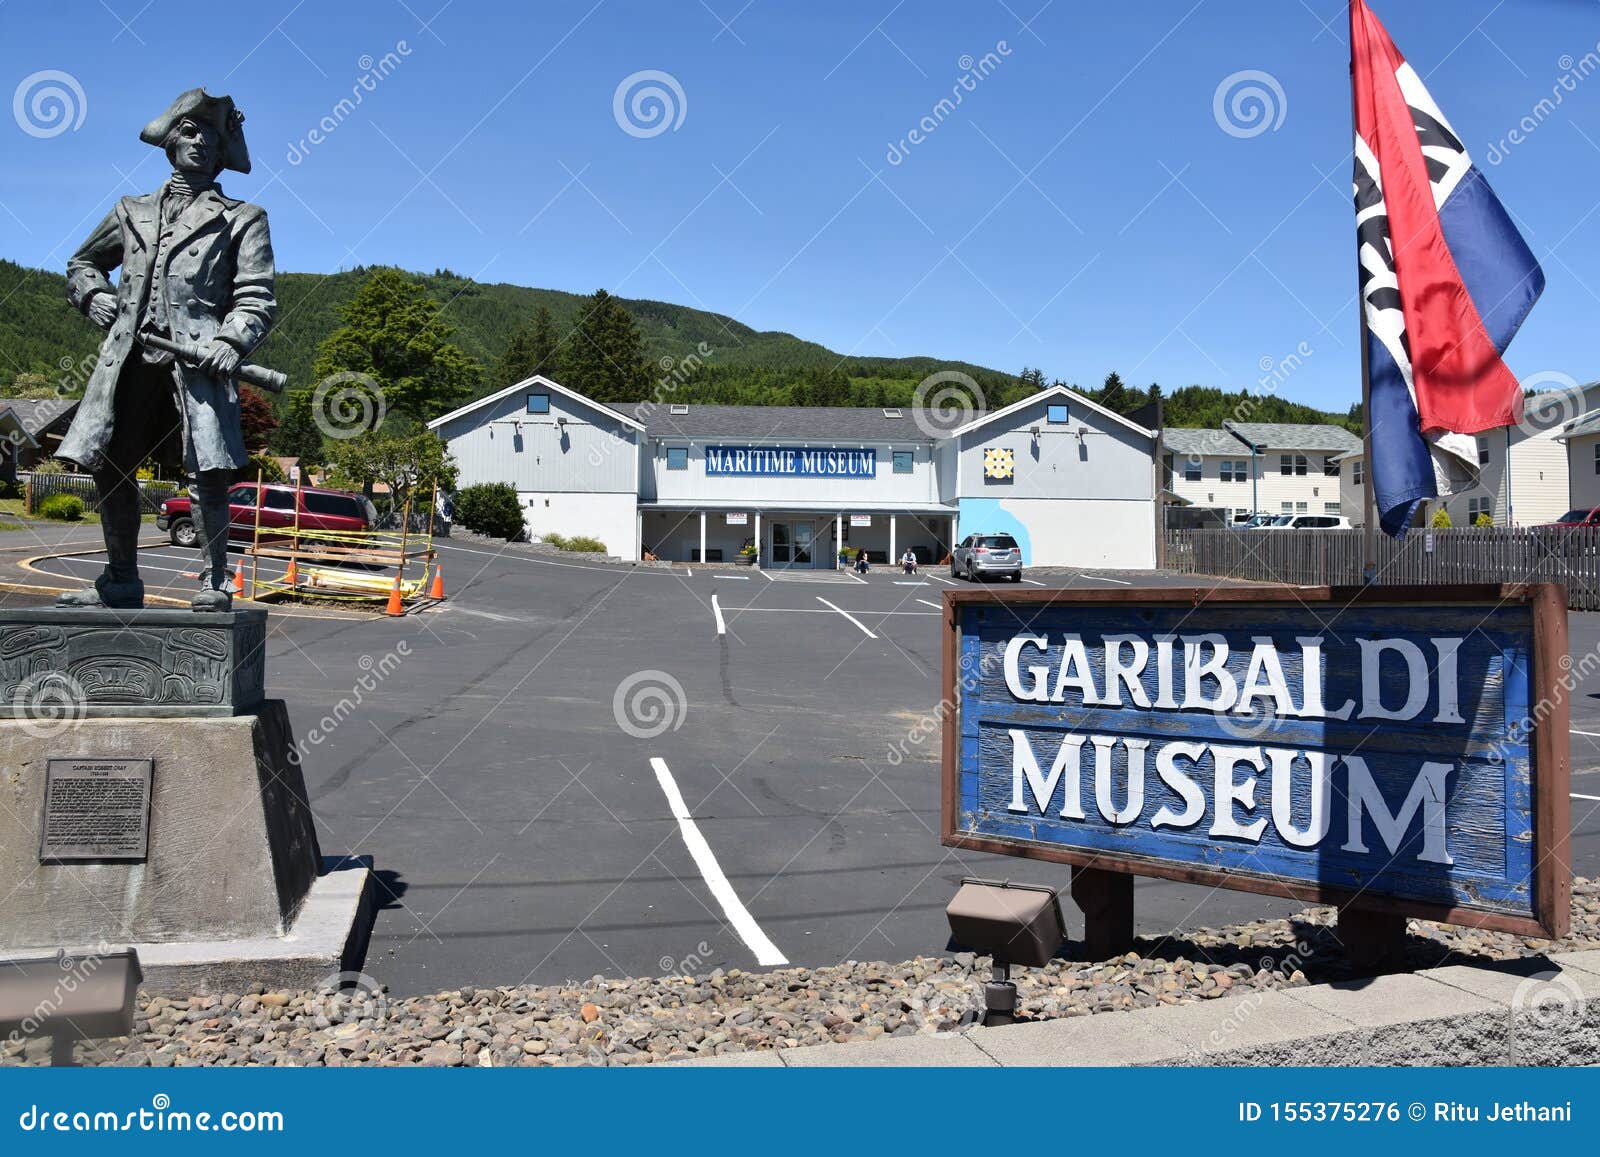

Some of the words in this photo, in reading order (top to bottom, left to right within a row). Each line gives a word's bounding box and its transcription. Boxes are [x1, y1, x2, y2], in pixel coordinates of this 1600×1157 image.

[708, 449, 796, 473] MARITIME
[801, 451, 874, 475] MUSEUM
[1003, 632, 1466, 724] GARIBALDI
[1007, 729, 1455, 865] MUSEUM
